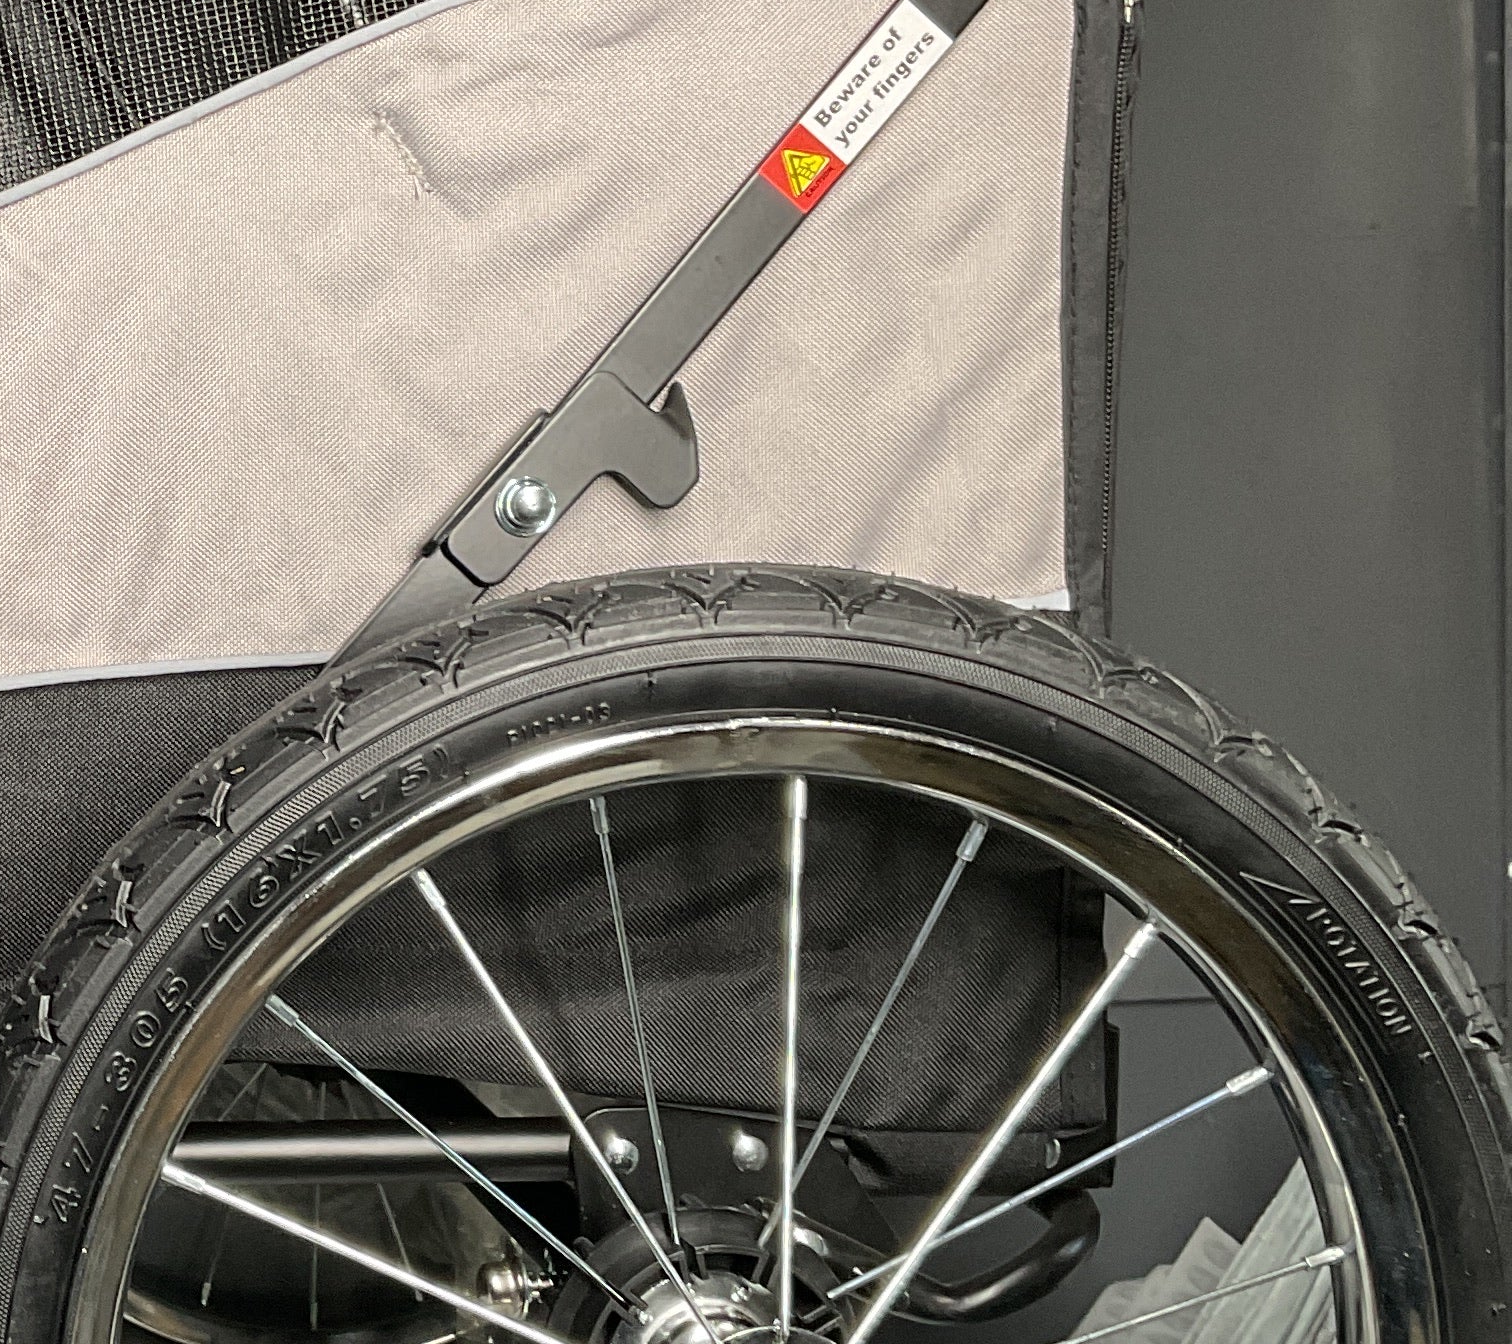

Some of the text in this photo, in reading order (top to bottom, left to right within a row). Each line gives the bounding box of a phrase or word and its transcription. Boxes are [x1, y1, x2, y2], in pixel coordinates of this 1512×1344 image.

[814, 25, 903, 127] Beware of
[835, 32, 935, 149] your fingers
[1306, 907, 1412, 1035] ROTATION
[51, 967, 189, 1223] 47-305
